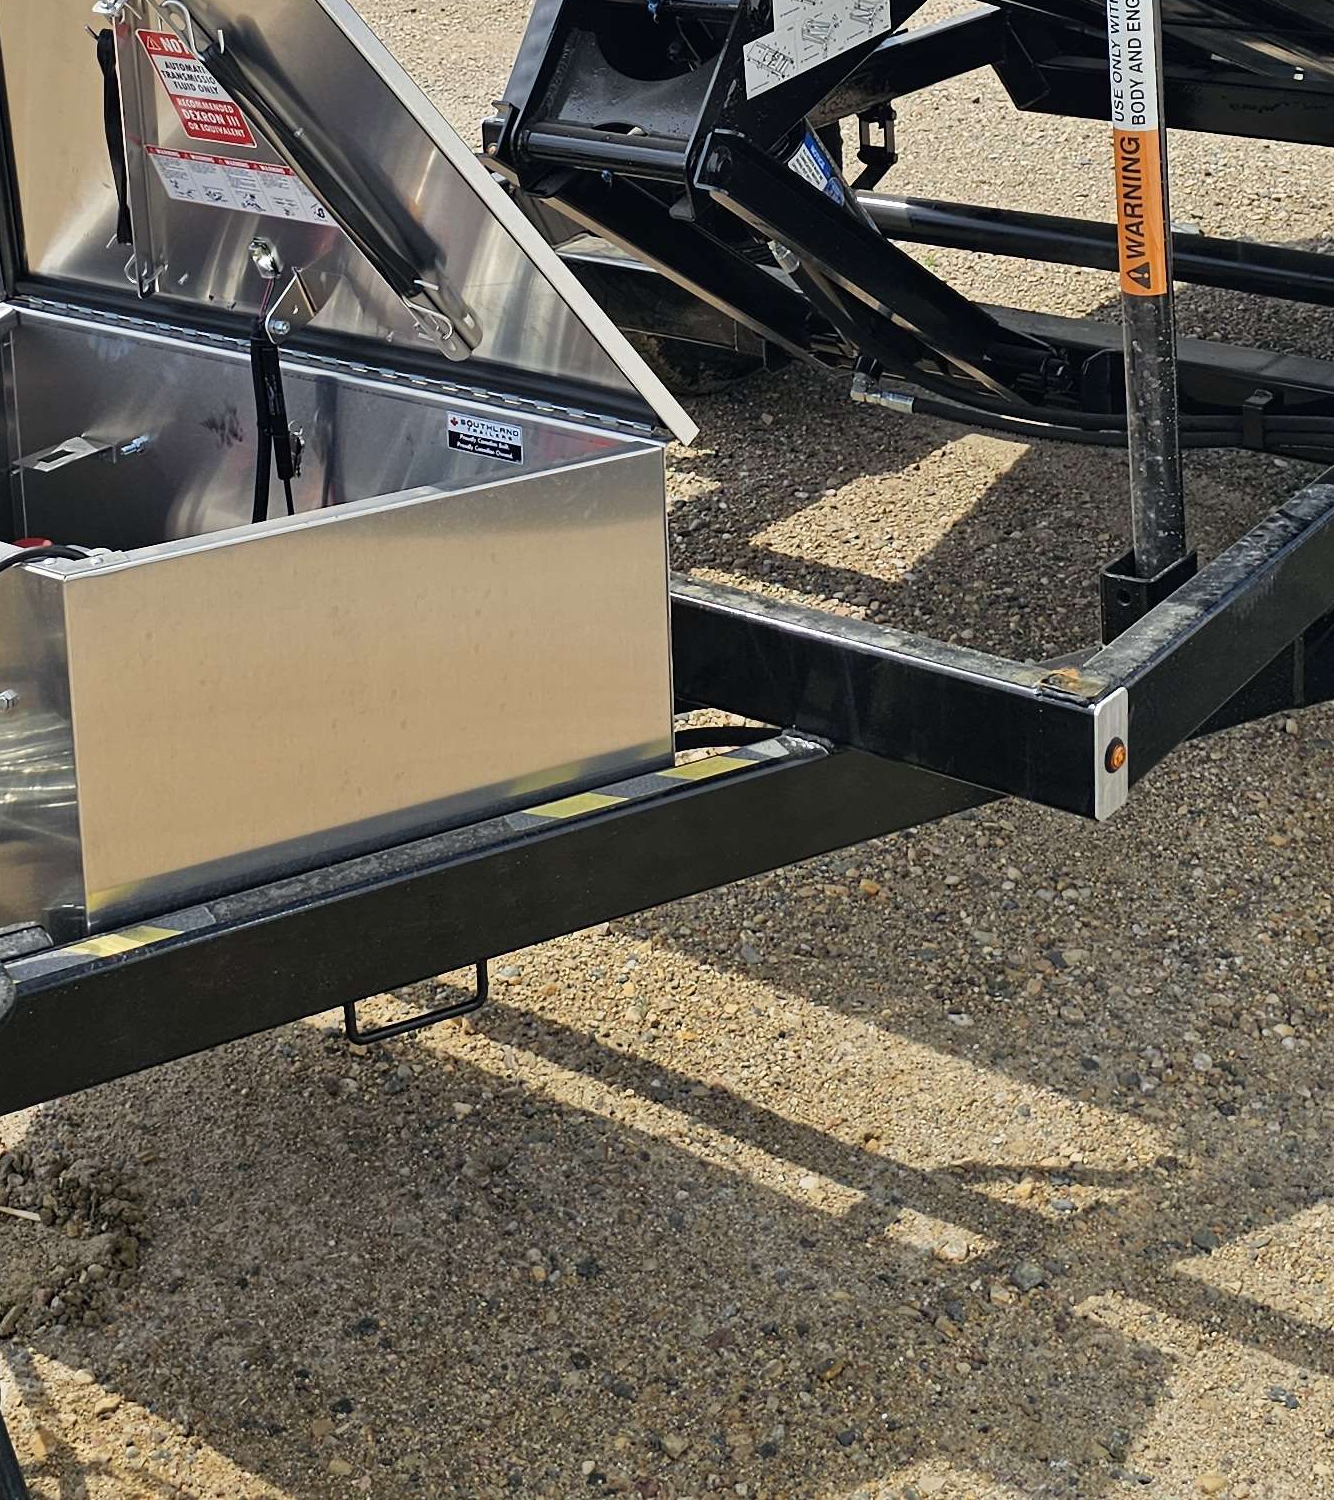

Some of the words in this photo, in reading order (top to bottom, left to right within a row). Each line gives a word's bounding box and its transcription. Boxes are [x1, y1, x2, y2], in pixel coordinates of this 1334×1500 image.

[1110, 39, 1124, 84] ONLY
[1128, 37, 1143, 74] AND
[164, 60, 206, 75] AUTOMATI
[161, 70, 217, 86] TRANSMISSIO
[173, 81, 197, 93] FLUID
[198, 83, 219, 95] ONLY
[176, 97, 234, 114] RECOMMENDED
[1114, 88, 1125, 122] USE
[1129, 78, 1146, 125] BODY
[182, 109, 227, 126] DEXRON
[187, 121, 200, 132] OR
[200, 123, 246, 139] EQUIVALENT
[1120, 136, 1146, 260] WARNING
[460, 419, 519, 437] SOUTHLAND
[468, 427, 513, 441] TRAILERS
